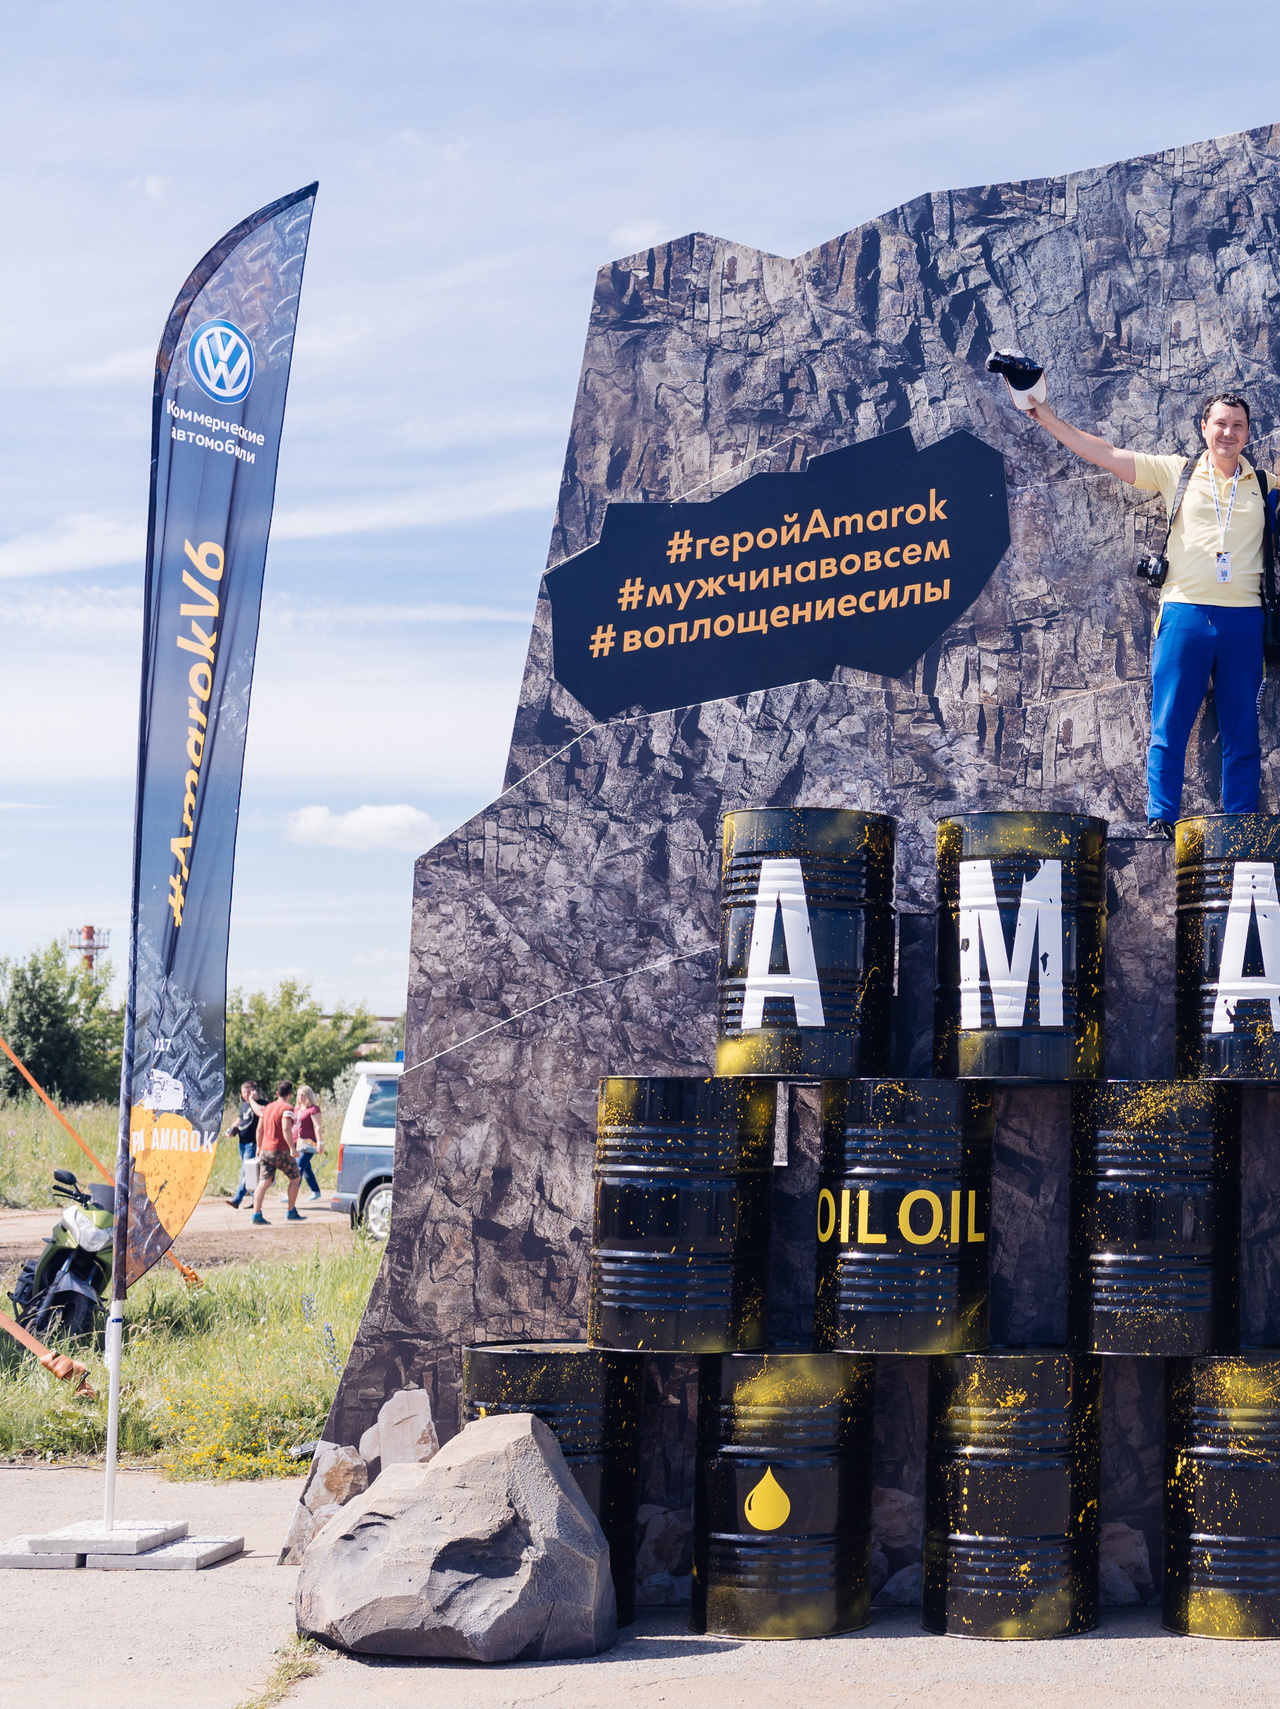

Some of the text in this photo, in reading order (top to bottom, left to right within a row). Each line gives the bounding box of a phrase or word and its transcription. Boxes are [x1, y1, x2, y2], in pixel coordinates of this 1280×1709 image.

[166, 398, 265, 446] Коммерческие
[171, 426, 256, 464] автомобили
[666, 488, 948, 564] #геройAmarok
[617, 538, 951, 611] #мужчинавовсем
[589, 577, 951, 658] #воплощениесилы
[168, 538, 226, 928] #AmarokV6
[151, 1127, 216, 1154] AMAROK
[817, 1188, 985, 1245] OIL OIL
